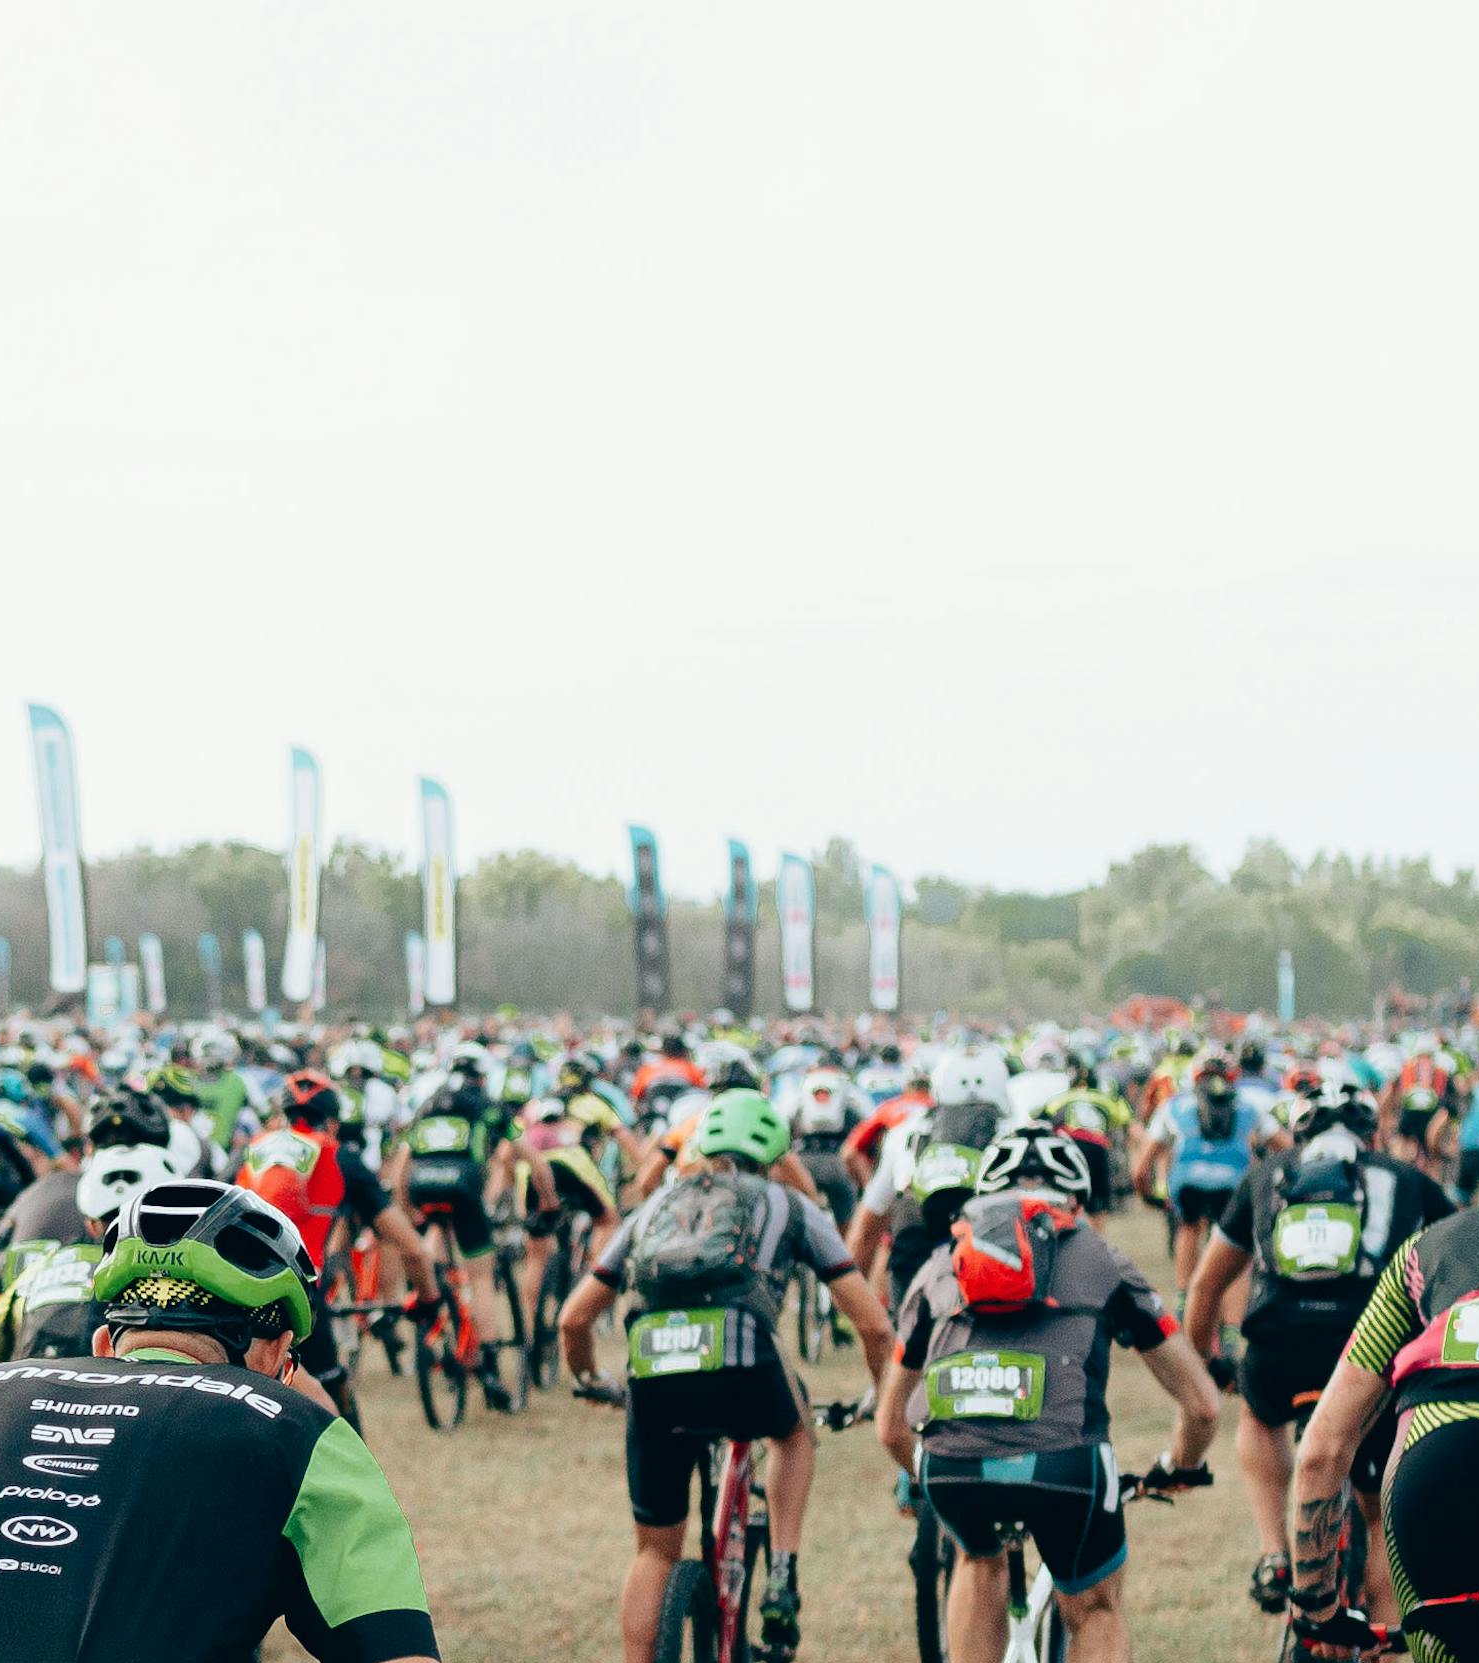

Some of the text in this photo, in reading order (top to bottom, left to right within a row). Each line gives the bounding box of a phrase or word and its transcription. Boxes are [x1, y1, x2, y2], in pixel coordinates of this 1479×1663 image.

[137, 1250, 184, 1266] KASK
[30, 1399, 140, 1417] SHIMANO
[31, 1424, 115, 1445] ENVE
[37, 1458, 99, 1472] SCHWALBE
[11, 1521, 66, 1540] NW
[20, 1562, 62, 1576] SUGOI
